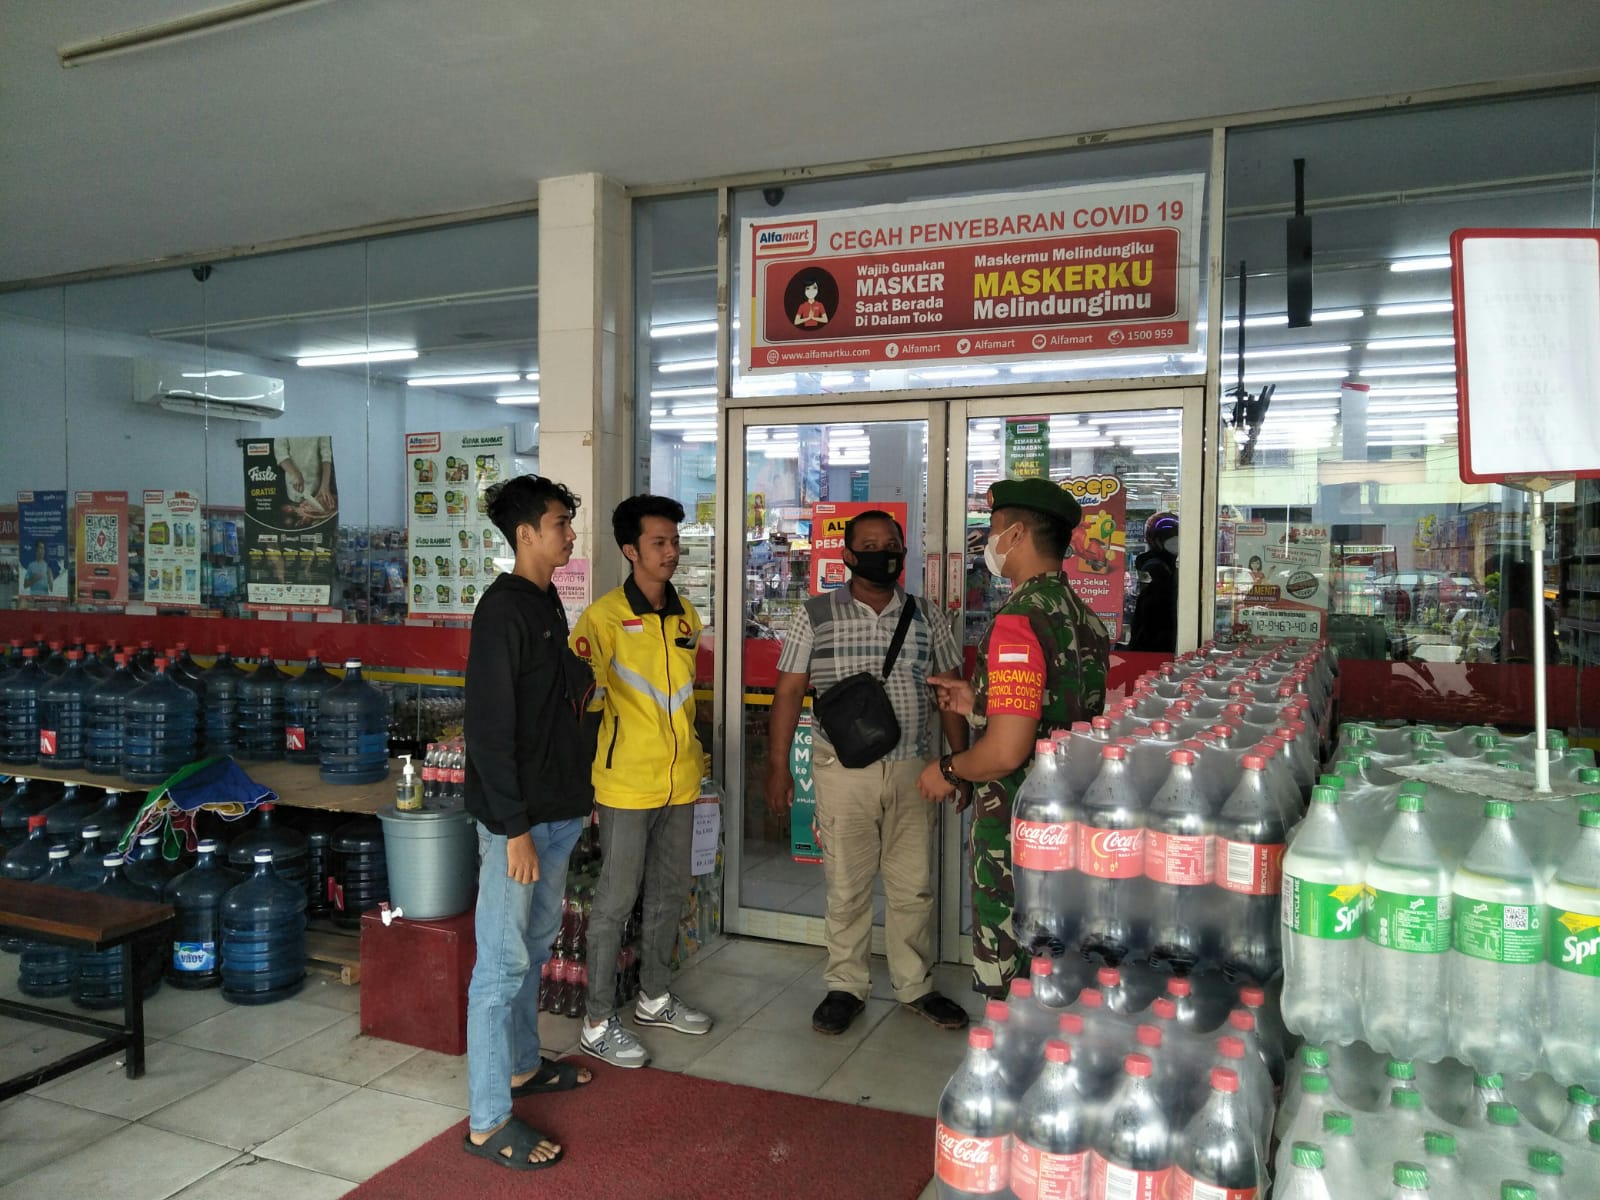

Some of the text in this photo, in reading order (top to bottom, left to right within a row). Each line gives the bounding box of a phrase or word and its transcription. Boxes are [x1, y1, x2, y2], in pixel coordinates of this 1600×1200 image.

[829, 200, 1184, 251] CEGAH PENYEBARAN COVID 19
[759, 228, 810, 244] Alfamart
[974, 241, 1154, 268] Maskermu Melindungiku
[856, 261, 945, 277] Wajib Gunakan
[856, 273, 945, 297] MASKER
[973, 259, 1153, 299] MASKERKU
[855, 296, 944, 314] Saat Berada
[973, 290, 1151, 321] Melindungimu
[855, 311, 943, 327] Di Dalam Toko
[781, 328, 1174, 361] www.alfamartku.com Alfamart Alfamart Alfamart 1500 959
[248, 465, 278, 482] Fissler
[250, 487, 277, 497] GRATIS!
[1302, 528, 1327, 537] SAPA
[815, 538, 845, 550] PESA
[576, 575, 585, 583] 19
[1083, 578, 1110, 587] Sekat,
[1080, 587, 1110, 596] Ongkir
[988, 669, 1042, 687] PENGAWAS
[1015, 821, 1069, 846] Coca-Cola
[1262, 848, 1268, 857] ME
[1294, 879, 1300, 892] ME
[1562, 936, 1600, 965] Spr
[937, 1124, 991, 1164] Coca-Cola
